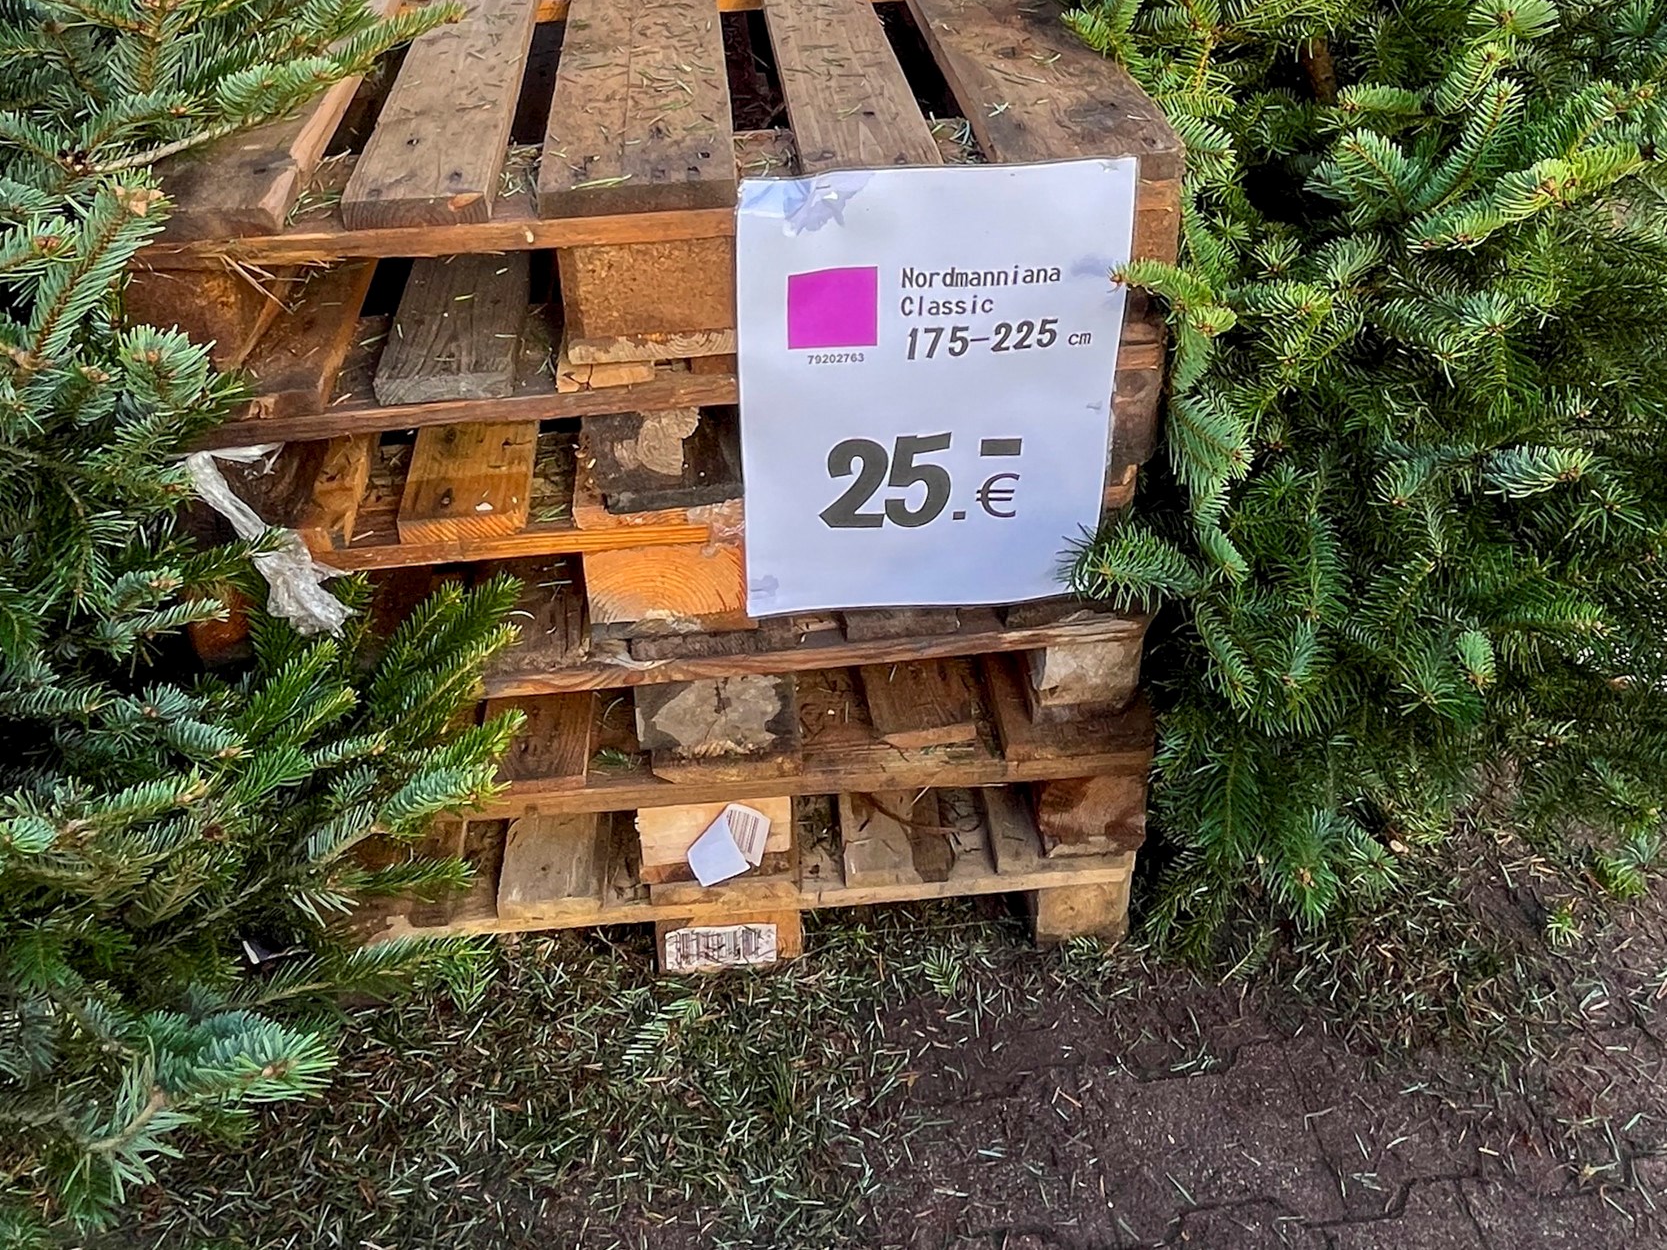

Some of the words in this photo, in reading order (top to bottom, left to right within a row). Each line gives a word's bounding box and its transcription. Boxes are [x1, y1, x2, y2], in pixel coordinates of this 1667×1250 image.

[901, 265, 1062, 288] Nordmanniana
[900, 295, 994, 316] Classic
[907, 318, 1059, 360] 175-225
[1068, 331, 1092, 346] cm
[807, 353, 865, 364] 79202763
[975, 473, 1021, 518] €
